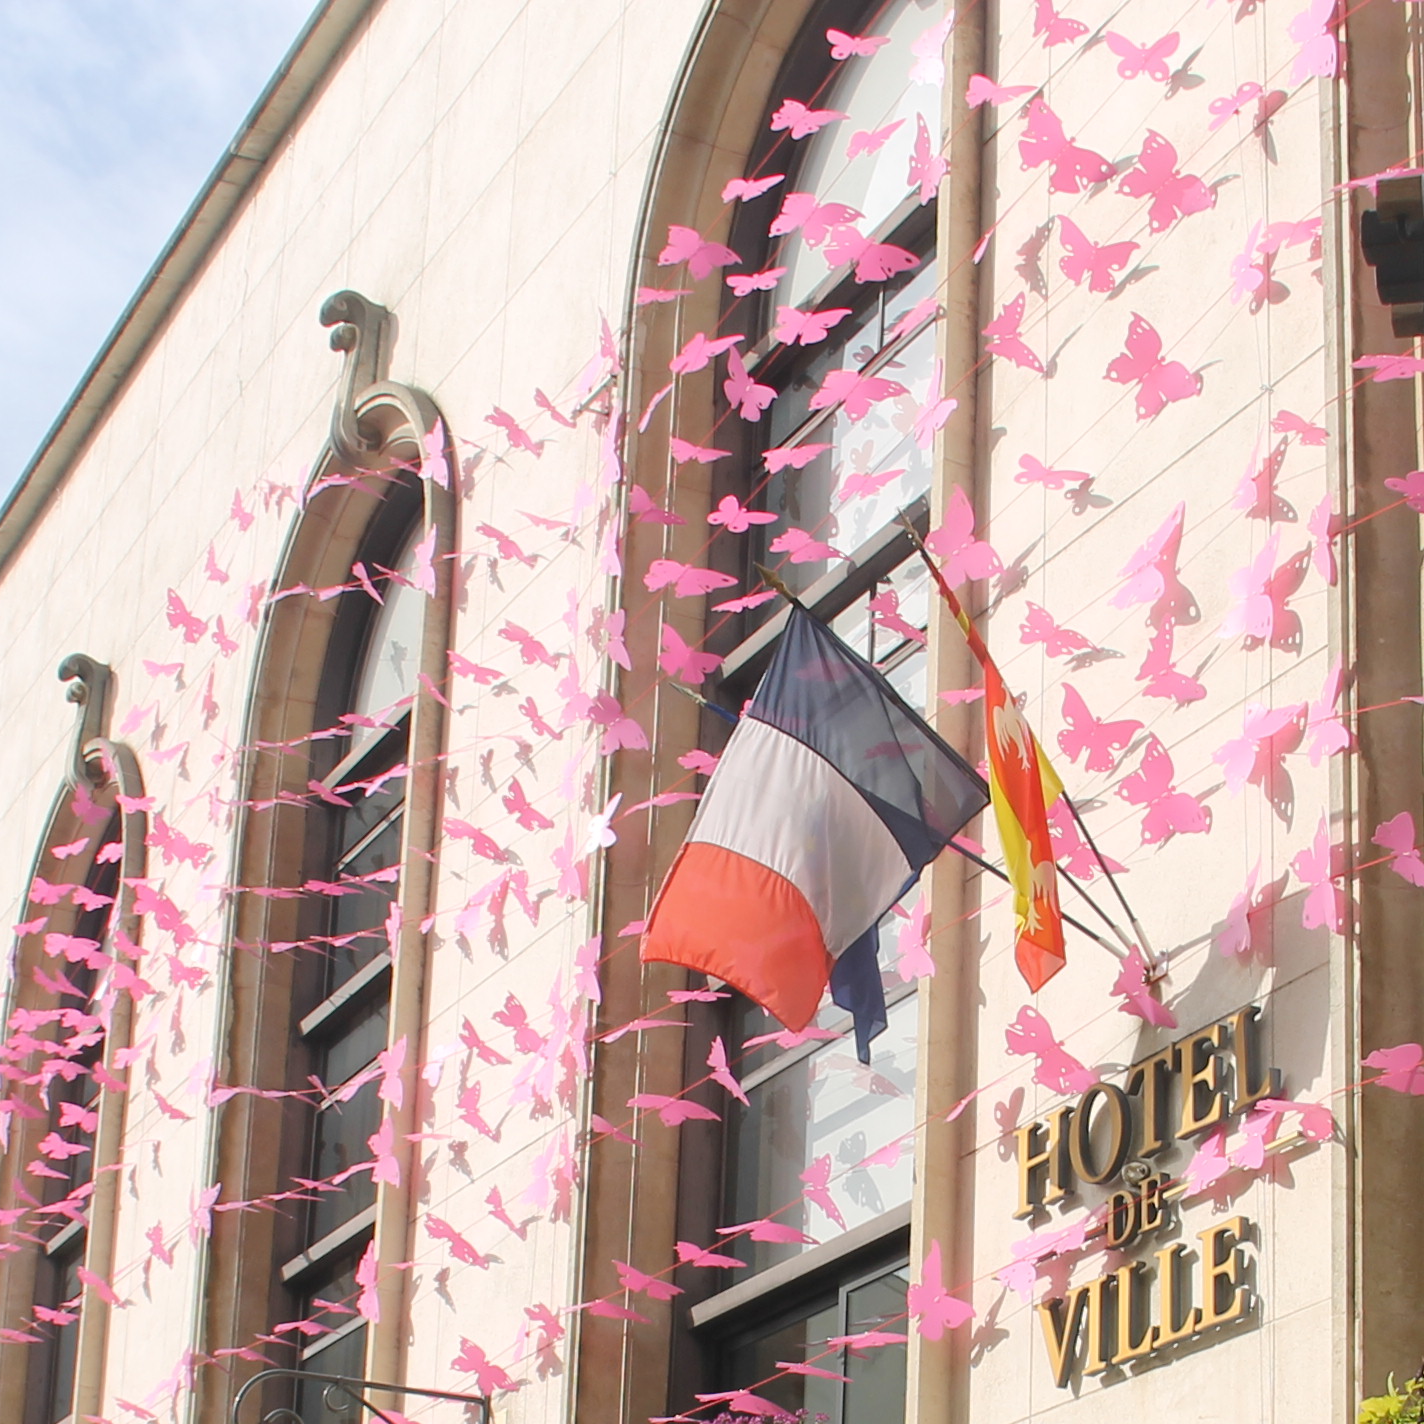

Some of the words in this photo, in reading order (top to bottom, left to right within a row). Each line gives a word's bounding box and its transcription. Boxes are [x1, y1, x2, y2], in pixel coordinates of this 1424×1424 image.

[1012, 1005, 1282, 1220] HOTEL
[1105, 1172, 1169, 1249] DE
[1035, 1216, 1260, 1388] VILLE
